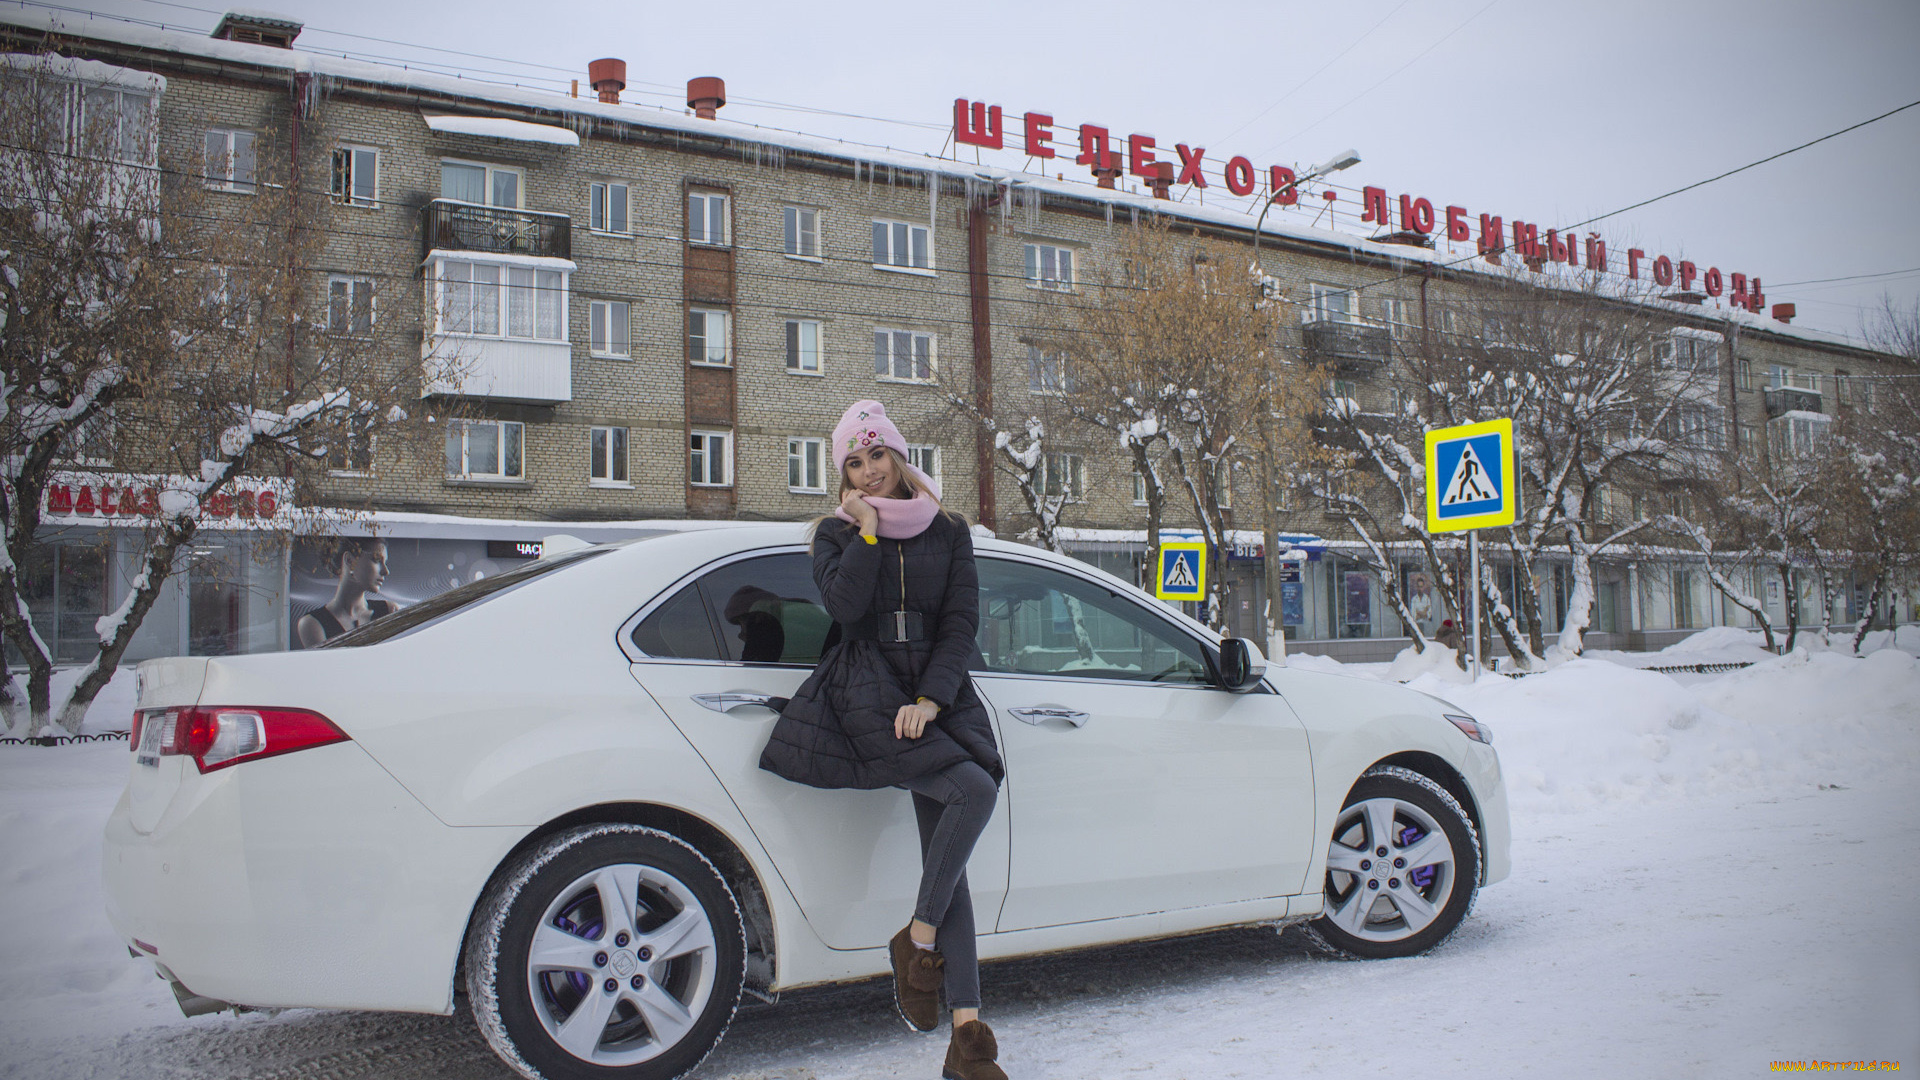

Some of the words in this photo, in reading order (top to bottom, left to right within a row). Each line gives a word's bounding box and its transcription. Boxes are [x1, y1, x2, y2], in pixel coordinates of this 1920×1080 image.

[954, 97, 1298, 206] ШЕЛЕХОВ
[1361, 185, 1608, 272] ЛЮБИМЫЙ
[49, 484, 205, 515] МАГАЗ
